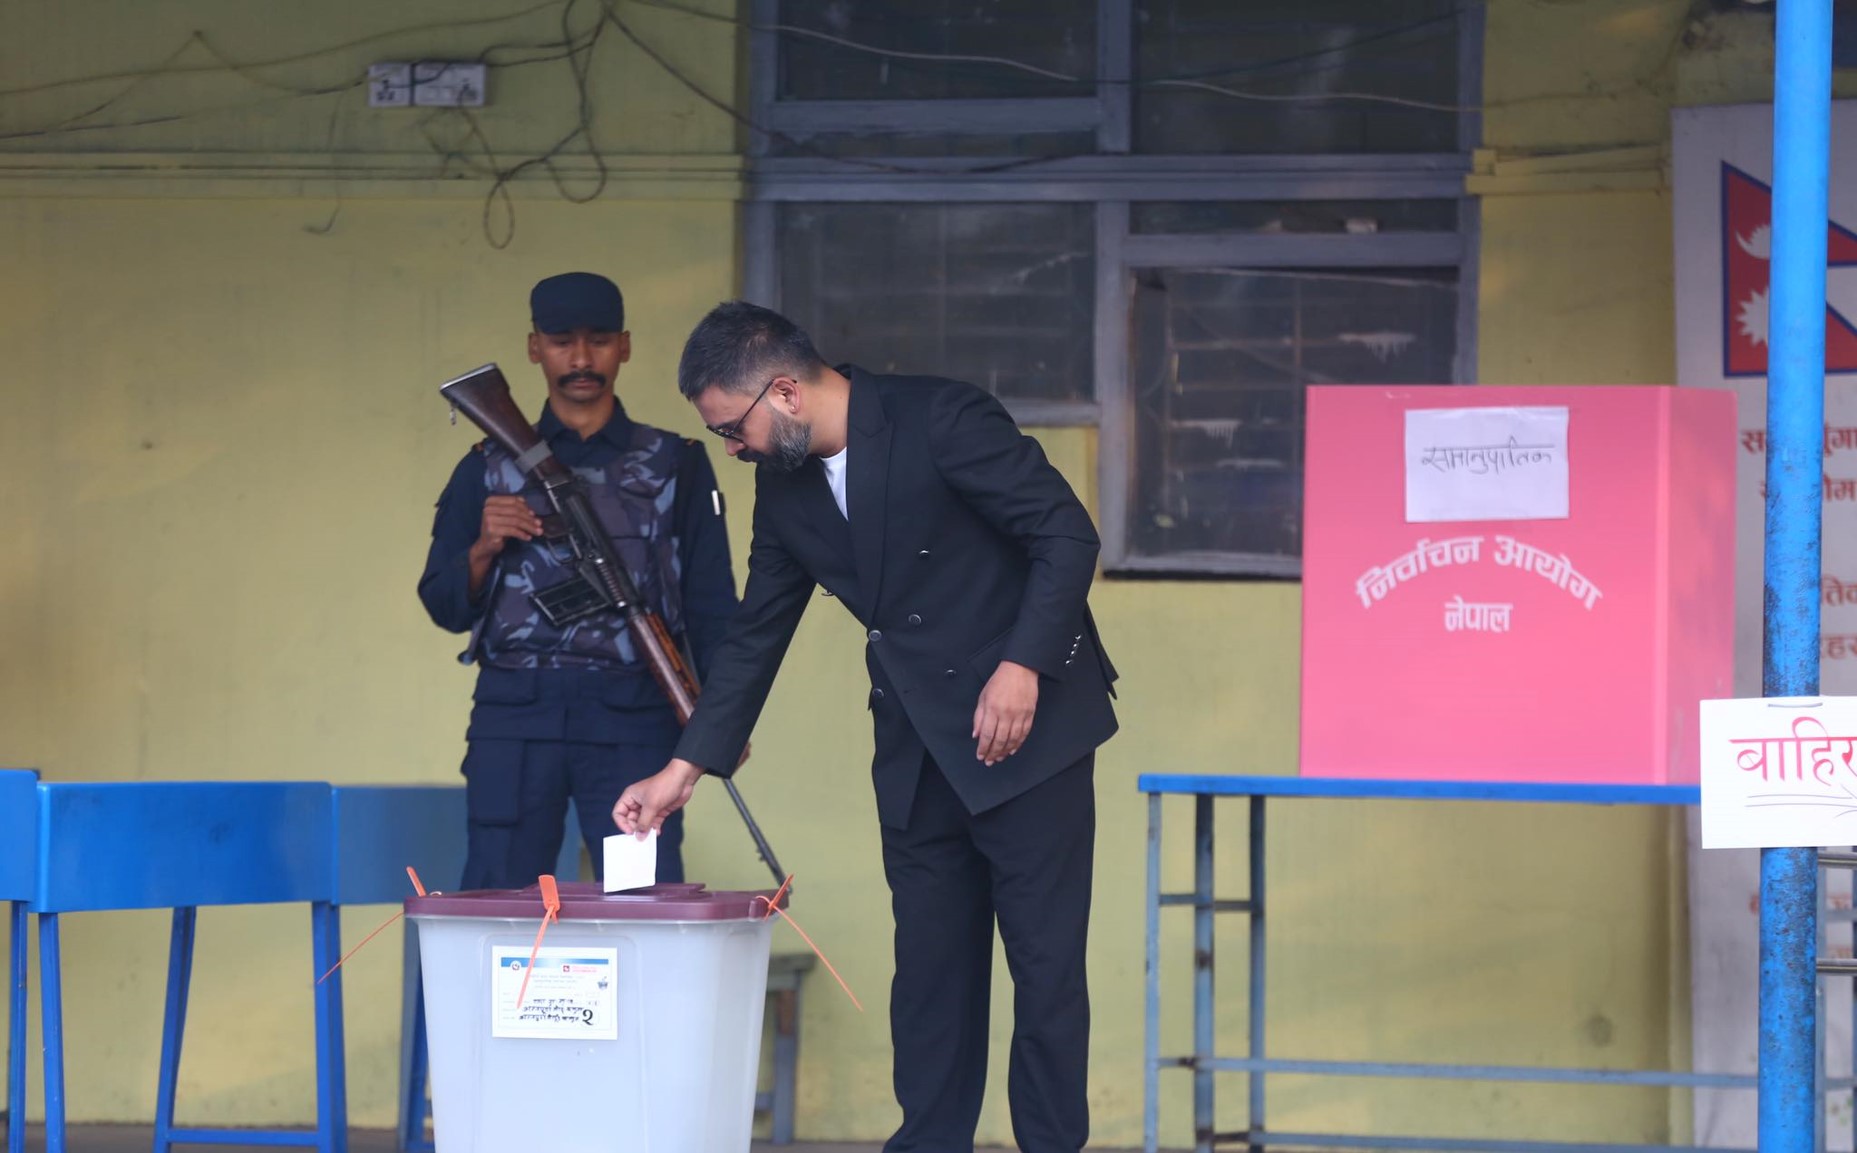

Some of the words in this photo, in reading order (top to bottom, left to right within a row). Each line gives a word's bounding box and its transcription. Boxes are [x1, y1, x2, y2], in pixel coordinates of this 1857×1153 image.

[1421, 434, 1555, 475] समानुपातिक
[1356, 535, 1485, 610] निर्वाचन
[1494, 534, 1603, 611] आयोग
[1444, 595, 1514, 633] नेपाल
